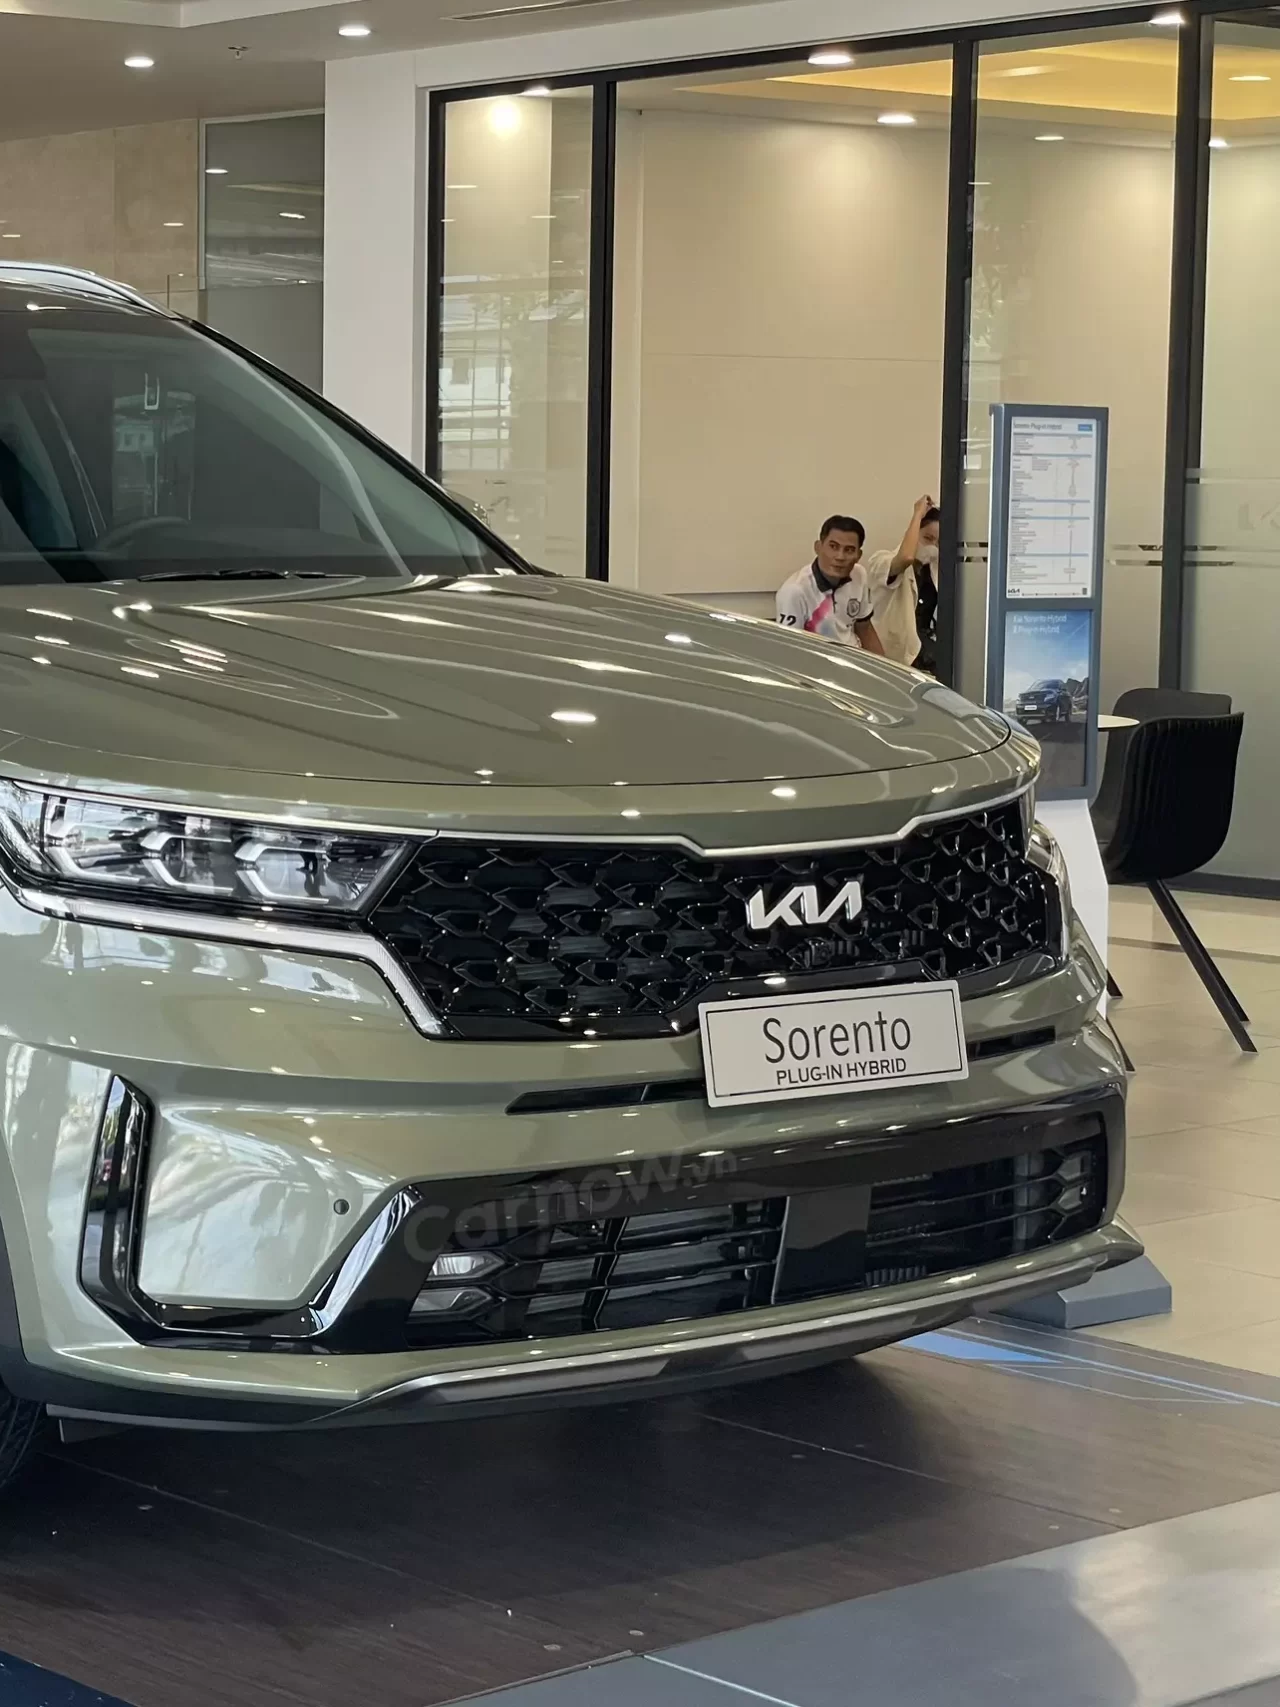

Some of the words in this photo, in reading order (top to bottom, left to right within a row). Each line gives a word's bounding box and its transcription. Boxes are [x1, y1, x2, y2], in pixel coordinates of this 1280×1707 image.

[746, 880, 863, 930] KIA
[763, 1011, 911, 1064] Sorento
[776, 1063, 843, 1085] PLUG-IN
[847, 1057, 907, 1078] HYBRID
